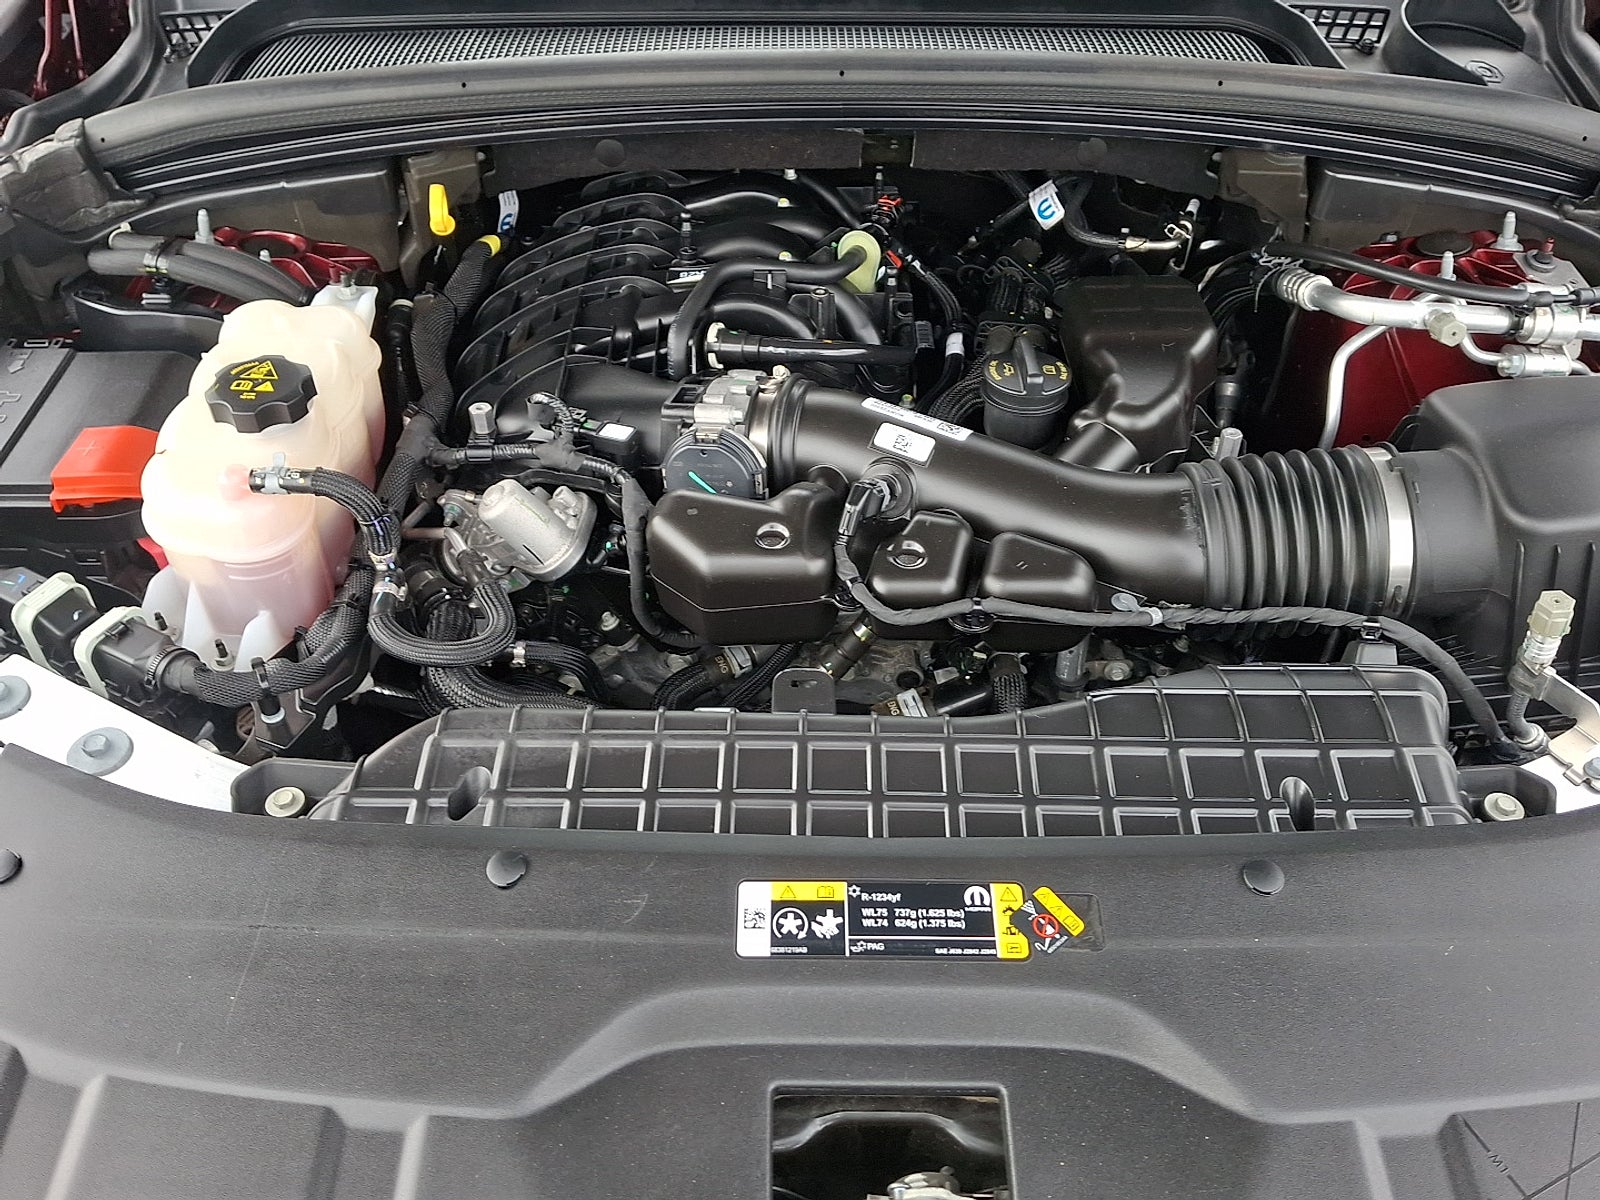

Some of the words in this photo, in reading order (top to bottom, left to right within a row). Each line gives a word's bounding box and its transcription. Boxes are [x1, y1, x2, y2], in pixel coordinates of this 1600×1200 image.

[714, 655, 729, 673] ENG
[861, 893, 902, 903] R-1234yf
[861, 908, 888, 917] WL75
[894, 908, 917, 918] 737g
[917, 908, 946, 918] (1.625
[946, 908, 965, 918] lbs)
[862, 919, 888, 927] WL74
[894, 919, 917, 929] 624g
[918, 919, 947, 929] (1.375
[947, 919, 966, 929] lbs)
[867, 942, 885, 951] PAG
